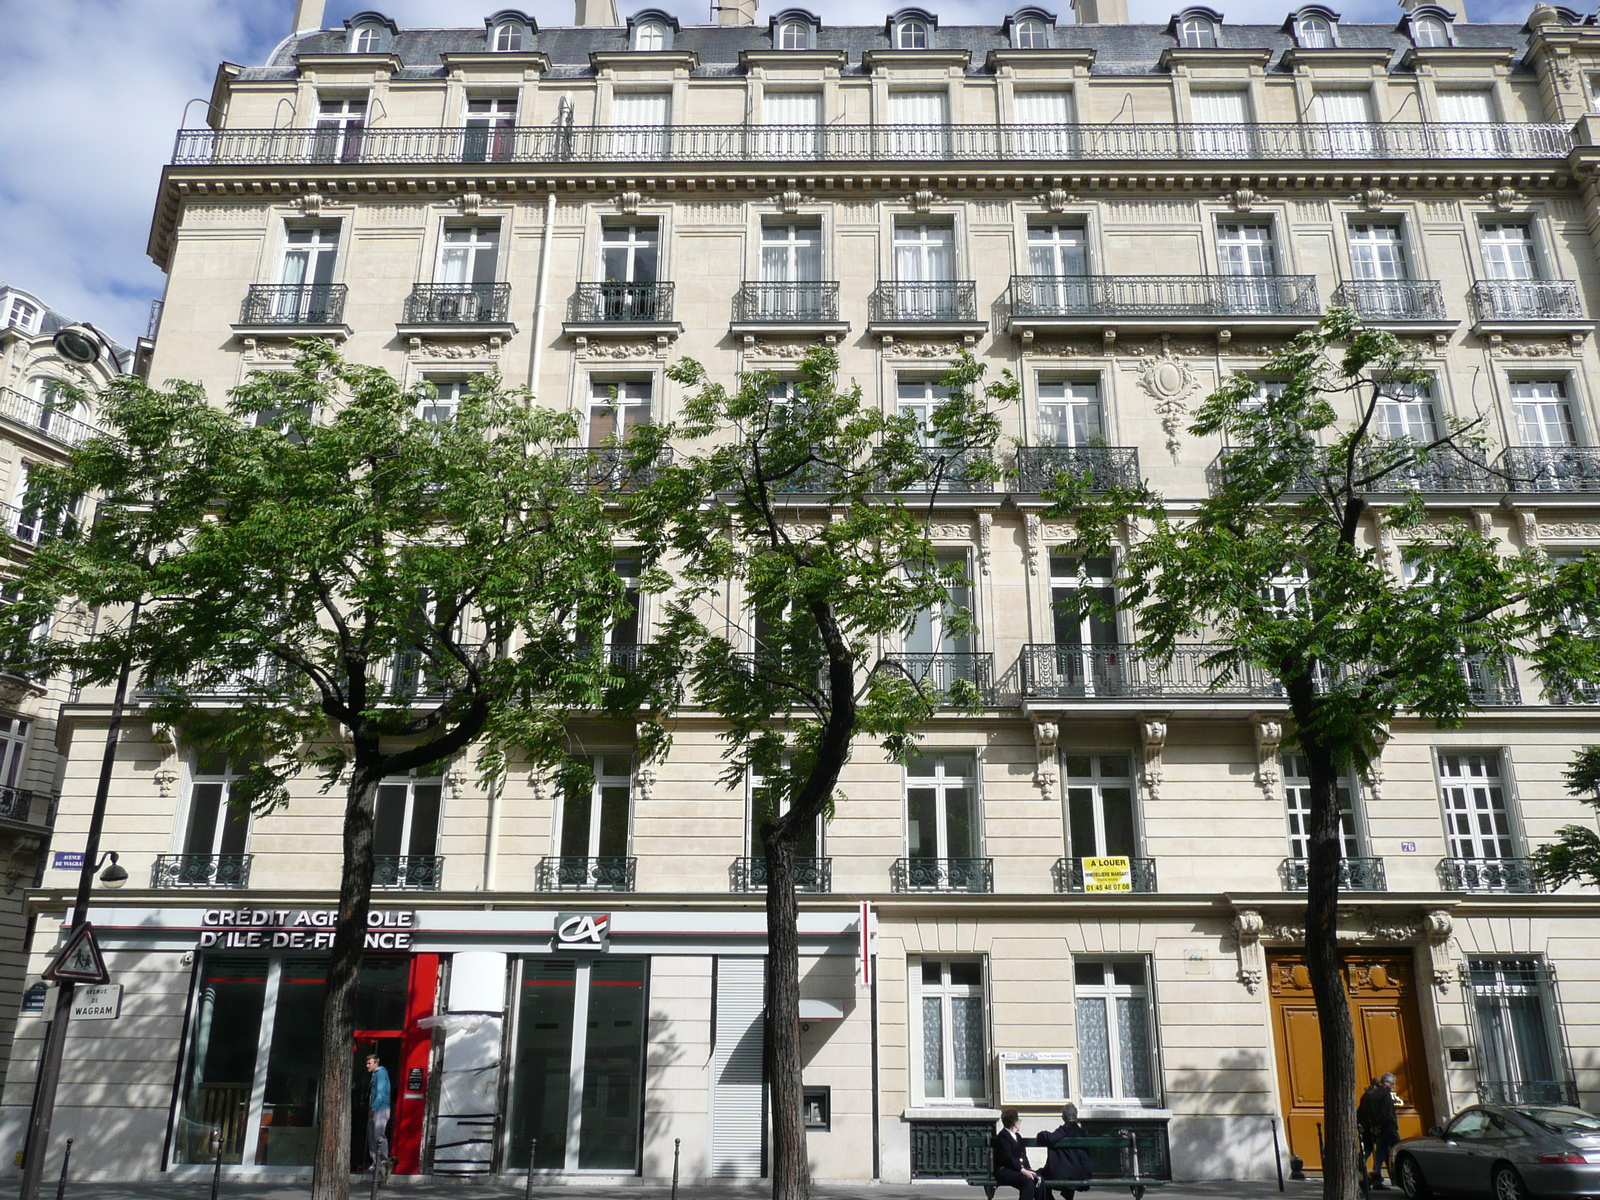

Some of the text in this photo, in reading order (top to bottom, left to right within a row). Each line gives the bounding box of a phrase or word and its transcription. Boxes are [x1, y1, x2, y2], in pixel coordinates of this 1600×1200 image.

[1402, 842, 1415, 852] 76
[203, 907, 413, 927] CRÉDIT AGROLE
[75, 1006, 113, 1016] WAGRAM
